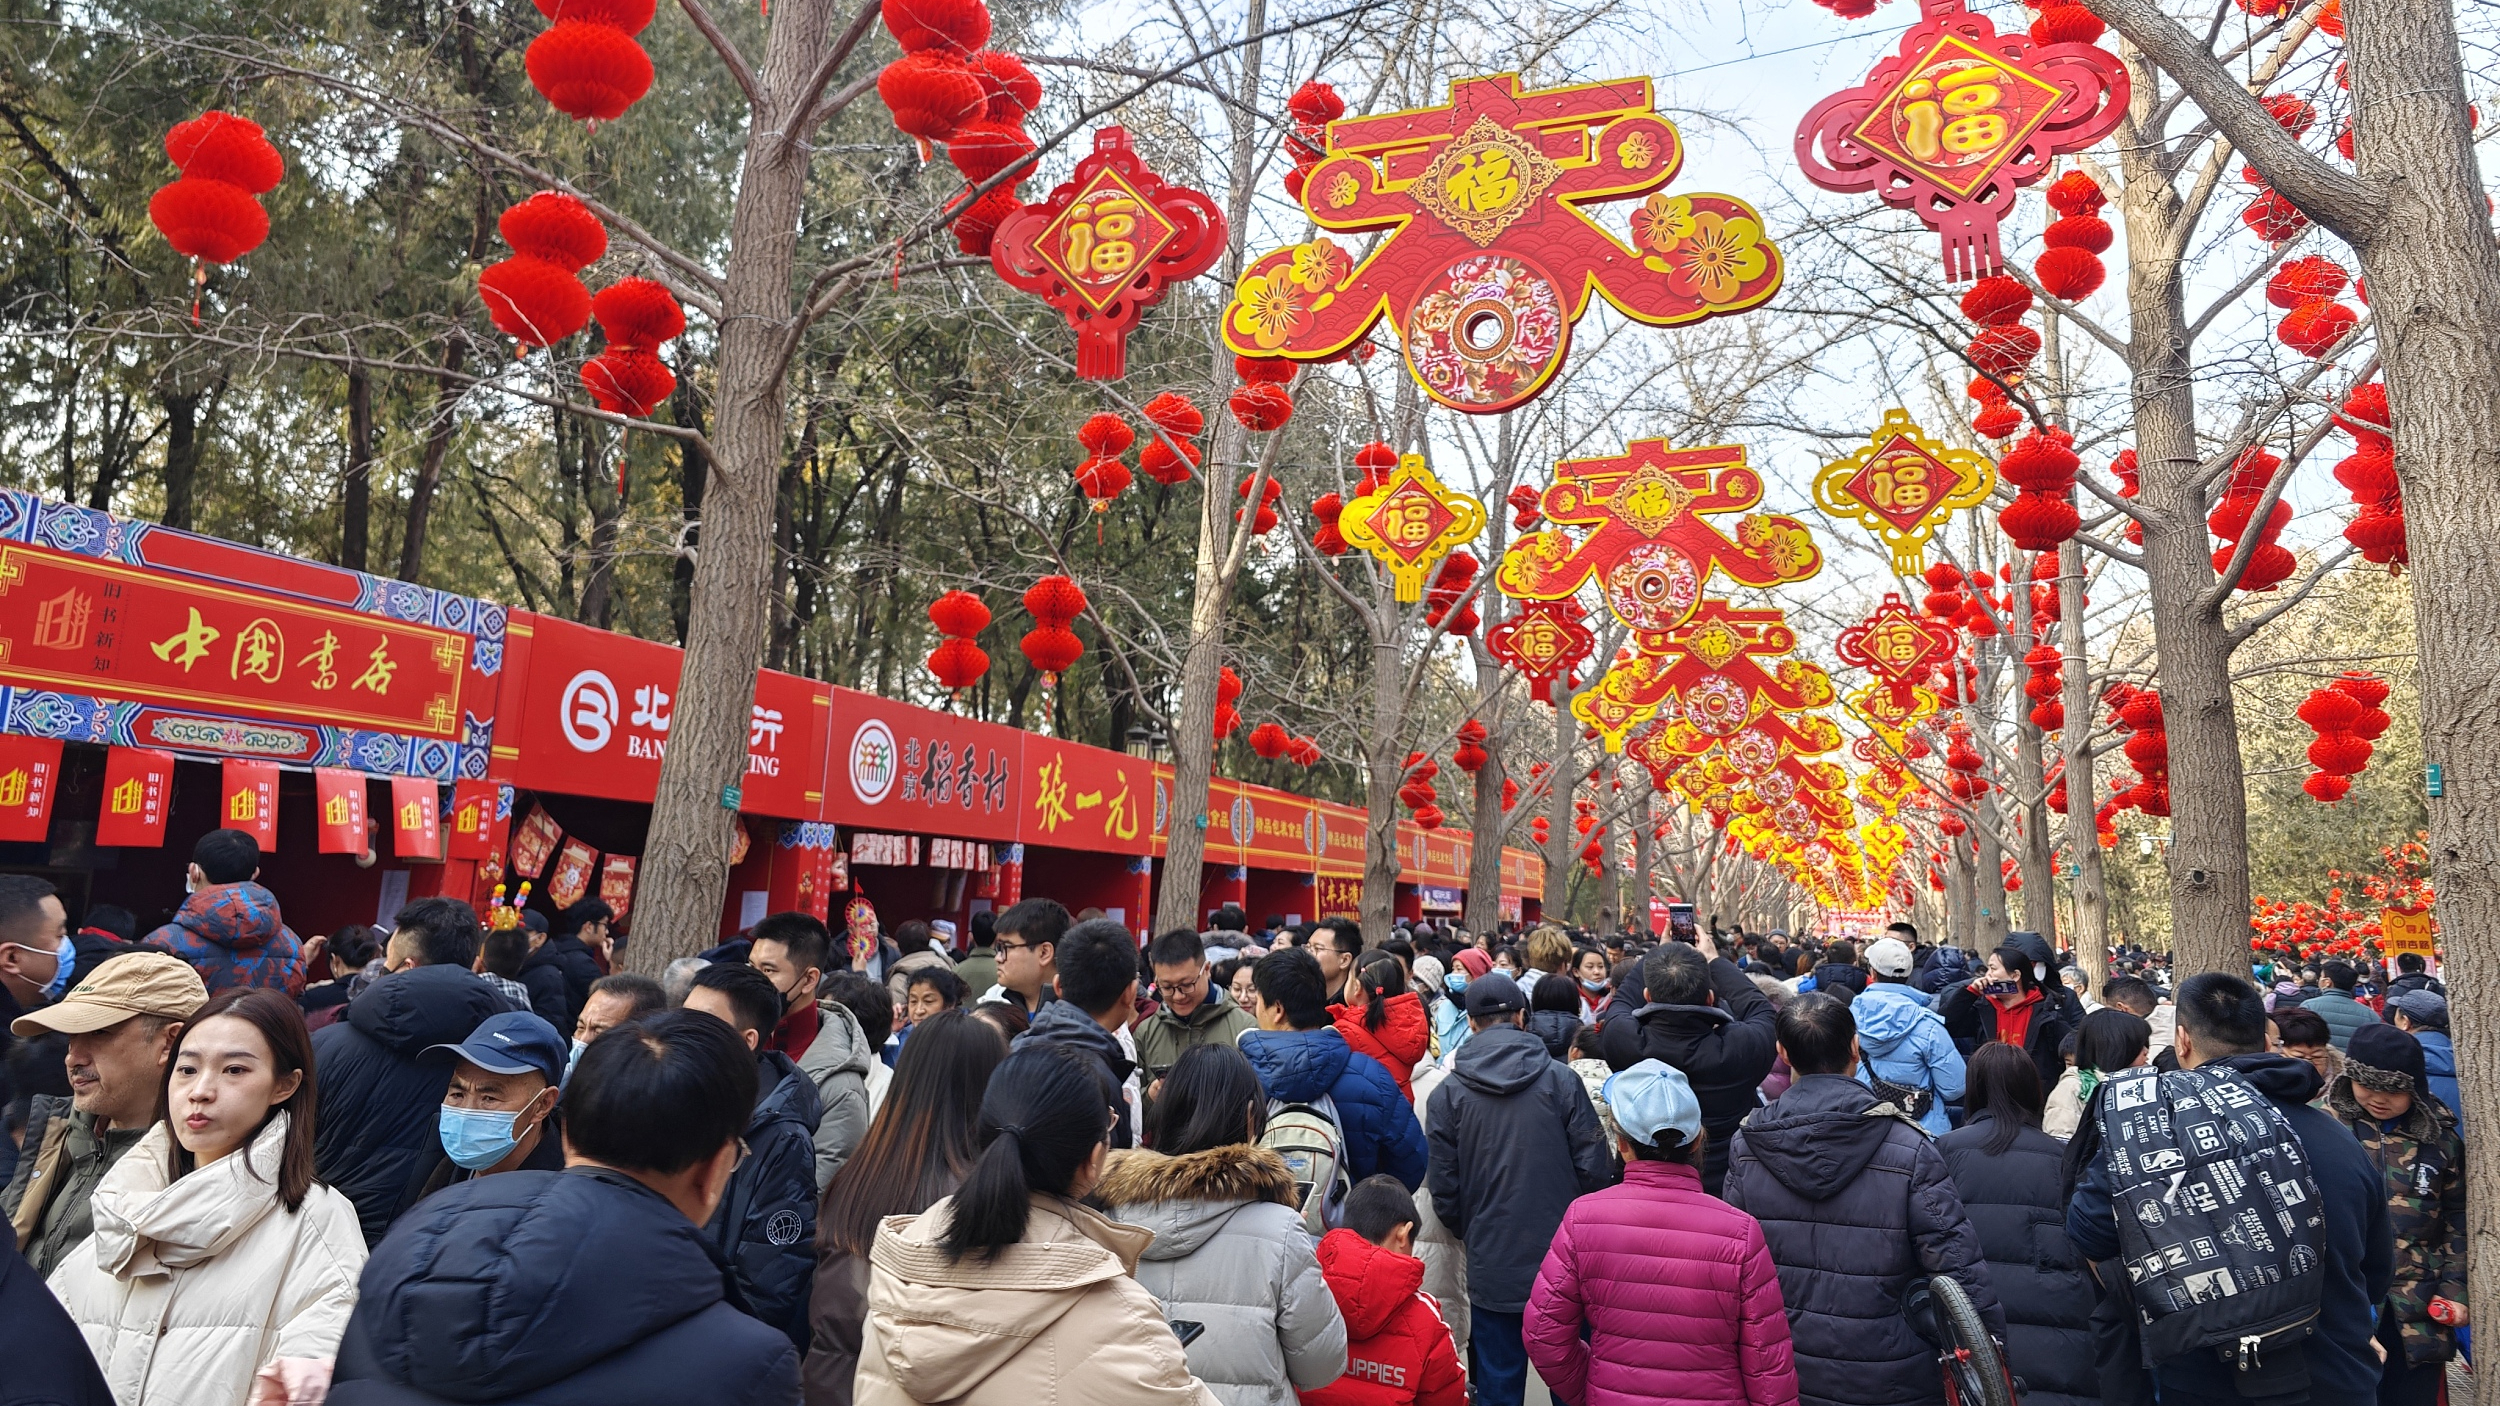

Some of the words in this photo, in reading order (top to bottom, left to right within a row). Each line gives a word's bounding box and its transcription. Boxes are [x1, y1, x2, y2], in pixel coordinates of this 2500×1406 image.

[1901, 63, 2008, 163] 福
[1446, 149, 1519, 213] 福
[1067, 198, 1136, 277] 福
[1626, 481, 1671, 519] 福
[1873, 455, 1932, 510] 福
[1387, 497, 1433, 542] 福
[92, 582, 122, 672] 旧书新知
[1520, 623, 1557, 658] 福
[1698, 629, 1732, 658] 福
[1876, 625, 1916, 660] 福
[627, 735, 667, 760] BAN
[901, 736, 920, 800] 北京
[920, 737, 1009, 814] 稻香村
[2215, 1082, 2253, 1109] CHI
[2147, 1115, 2160, 1134] LXVI
[2194, 1126, 2220, 1150] 66
[2259, 1170, 2274, 1186] CHI
[2189, 1181, 2220, 1213] CHI
[2241, 1215, 2264, 1251] BULLS
[2246, 1207, 2275, 1252] CHICAGO
[2195, 1240, 2213, 1257] 66
